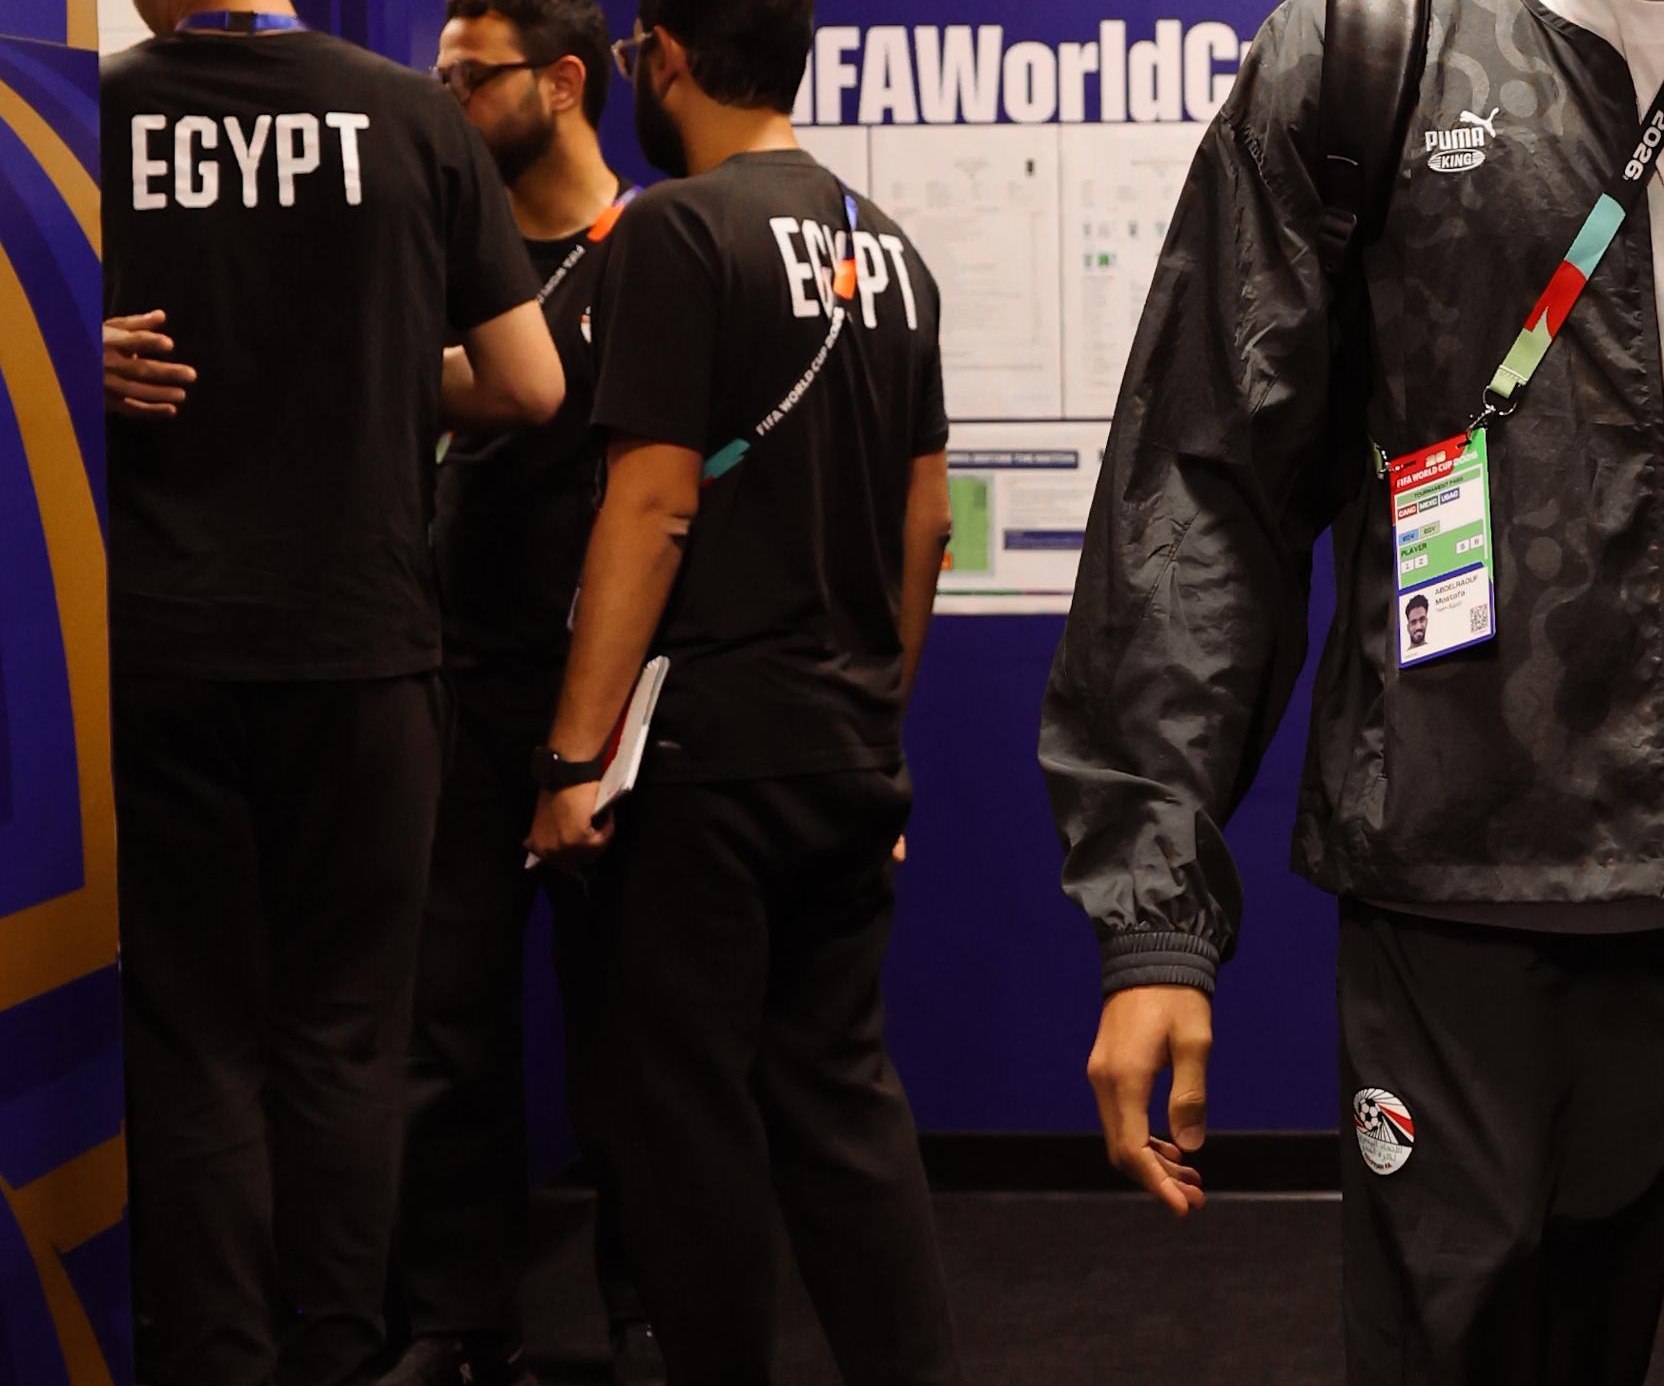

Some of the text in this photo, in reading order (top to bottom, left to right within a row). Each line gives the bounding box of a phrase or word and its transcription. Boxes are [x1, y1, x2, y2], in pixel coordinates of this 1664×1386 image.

[790, 19, 1252, 125] FAWorldC
[1424, 126, 1485, 152] PUMA
[131, 111, 370, 211] EGYPT
[1441, 153, 1473, 169] KING
[755, 410, 783, 436] FIFA
[778, 368, 815, 413] WORLD
[810, 344, 828, 373] CUP
[1396, 475, 1413, 489] FIFA
[1412, 465, 1438, 483] WORLD
[1437, 460, 1453, 472] CUP
[1401, 543, 1427, 556] PLAYER
